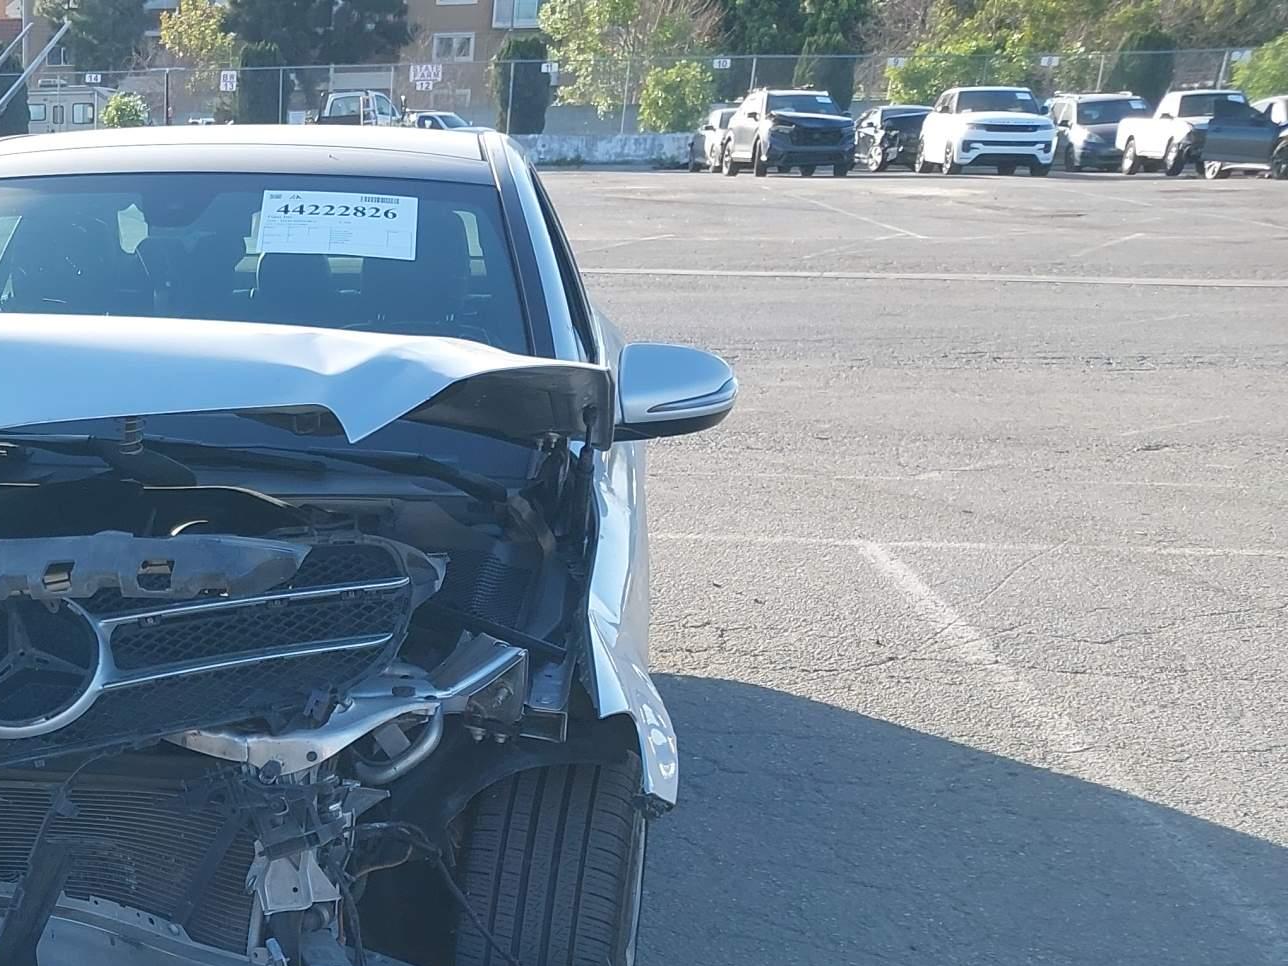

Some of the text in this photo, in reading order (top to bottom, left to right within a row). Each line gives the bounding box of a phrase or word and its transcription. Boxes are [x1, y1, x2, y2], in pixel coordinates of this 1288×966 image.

[718, 60, 728, 68] 10
[88, 74, 99, 83] 14
[224, 82, 234, 90] 13
[420, 82, 431, 90] 12
[276, 203, 398, 220] 44222826
